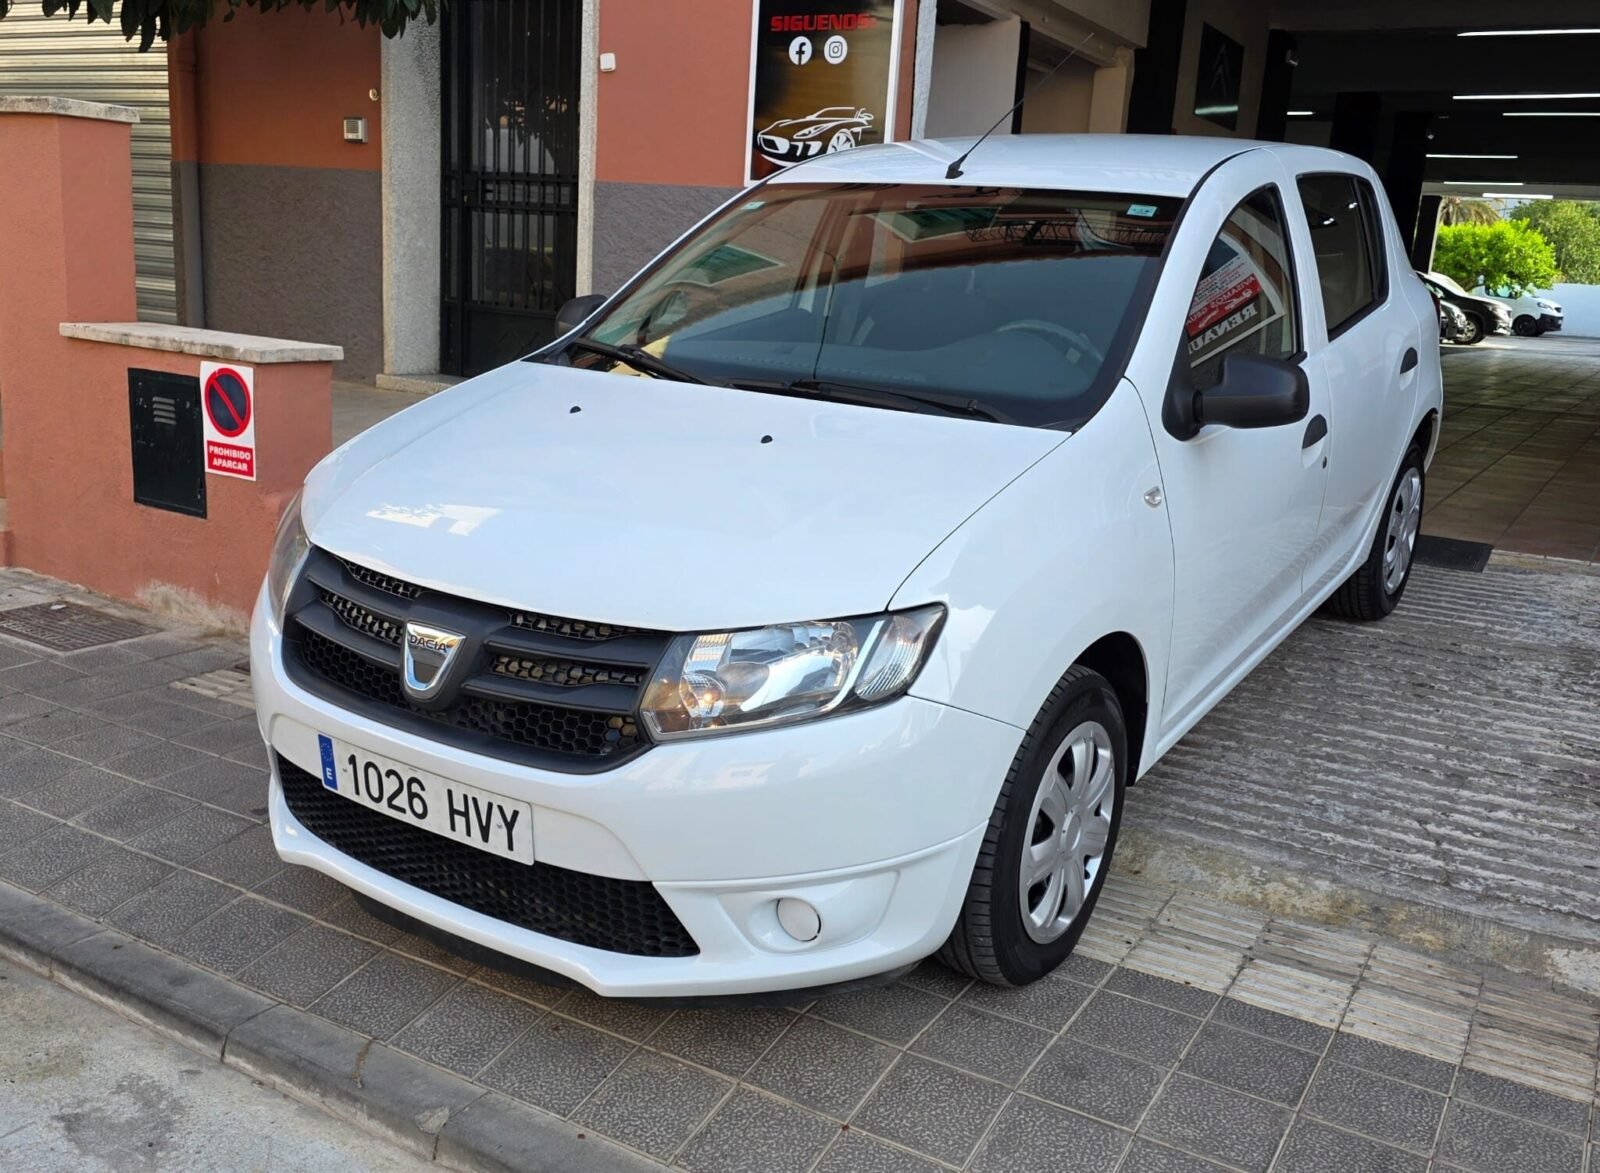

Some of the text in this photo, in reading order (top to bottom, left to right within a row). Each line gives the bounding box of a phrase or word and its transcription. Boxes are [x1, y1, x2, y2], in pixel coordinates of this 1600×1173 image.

[209, 445, 251, 461] PROHIBIDO
[213, 459, 248, 472] APARCAR
[409, 634, 448, 654] DACIA
[326, 767, 334, 780] E
[348, 754, 520, 852] 1026 HVY
